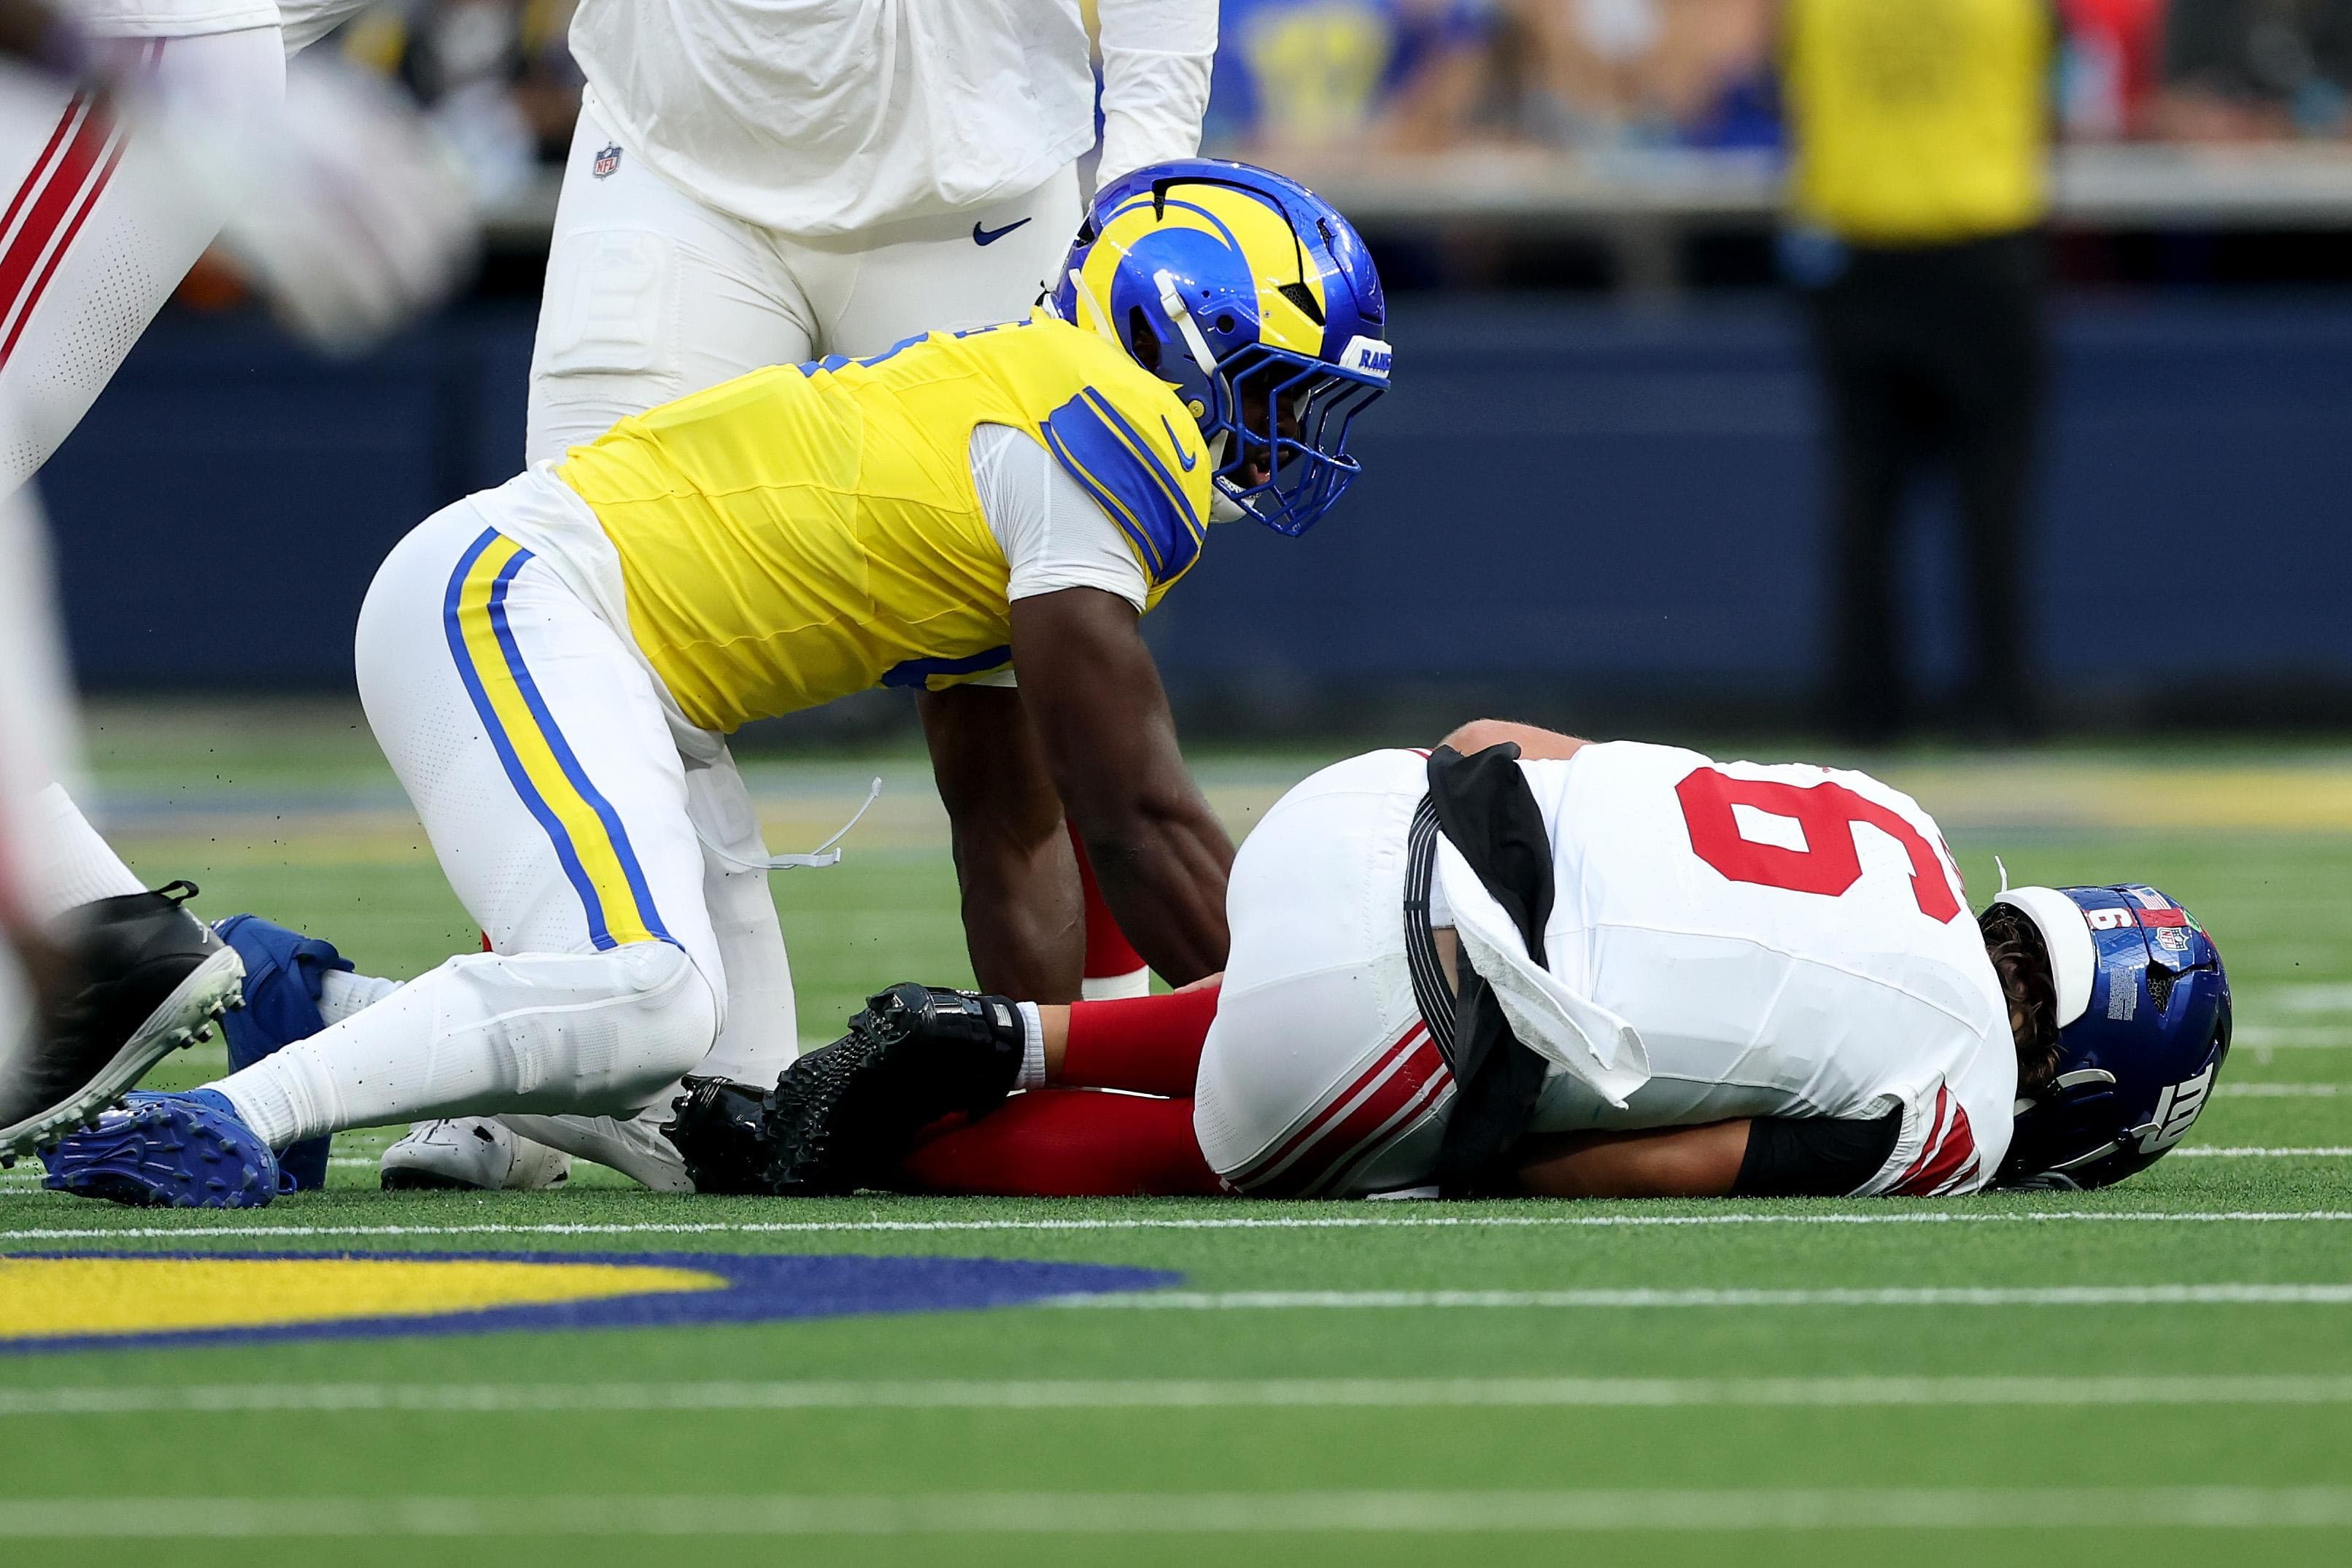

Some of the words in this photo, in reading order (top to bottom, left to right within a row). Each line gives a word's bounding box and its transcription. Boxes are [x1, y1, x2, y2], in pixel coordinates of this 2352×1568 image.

[595, 158, 615, 173] NFL
[1674, 766, 1961, 925] 6
[2087, 907, 2133, 931] 6
[2160, 930, 2175, 949] NFL
